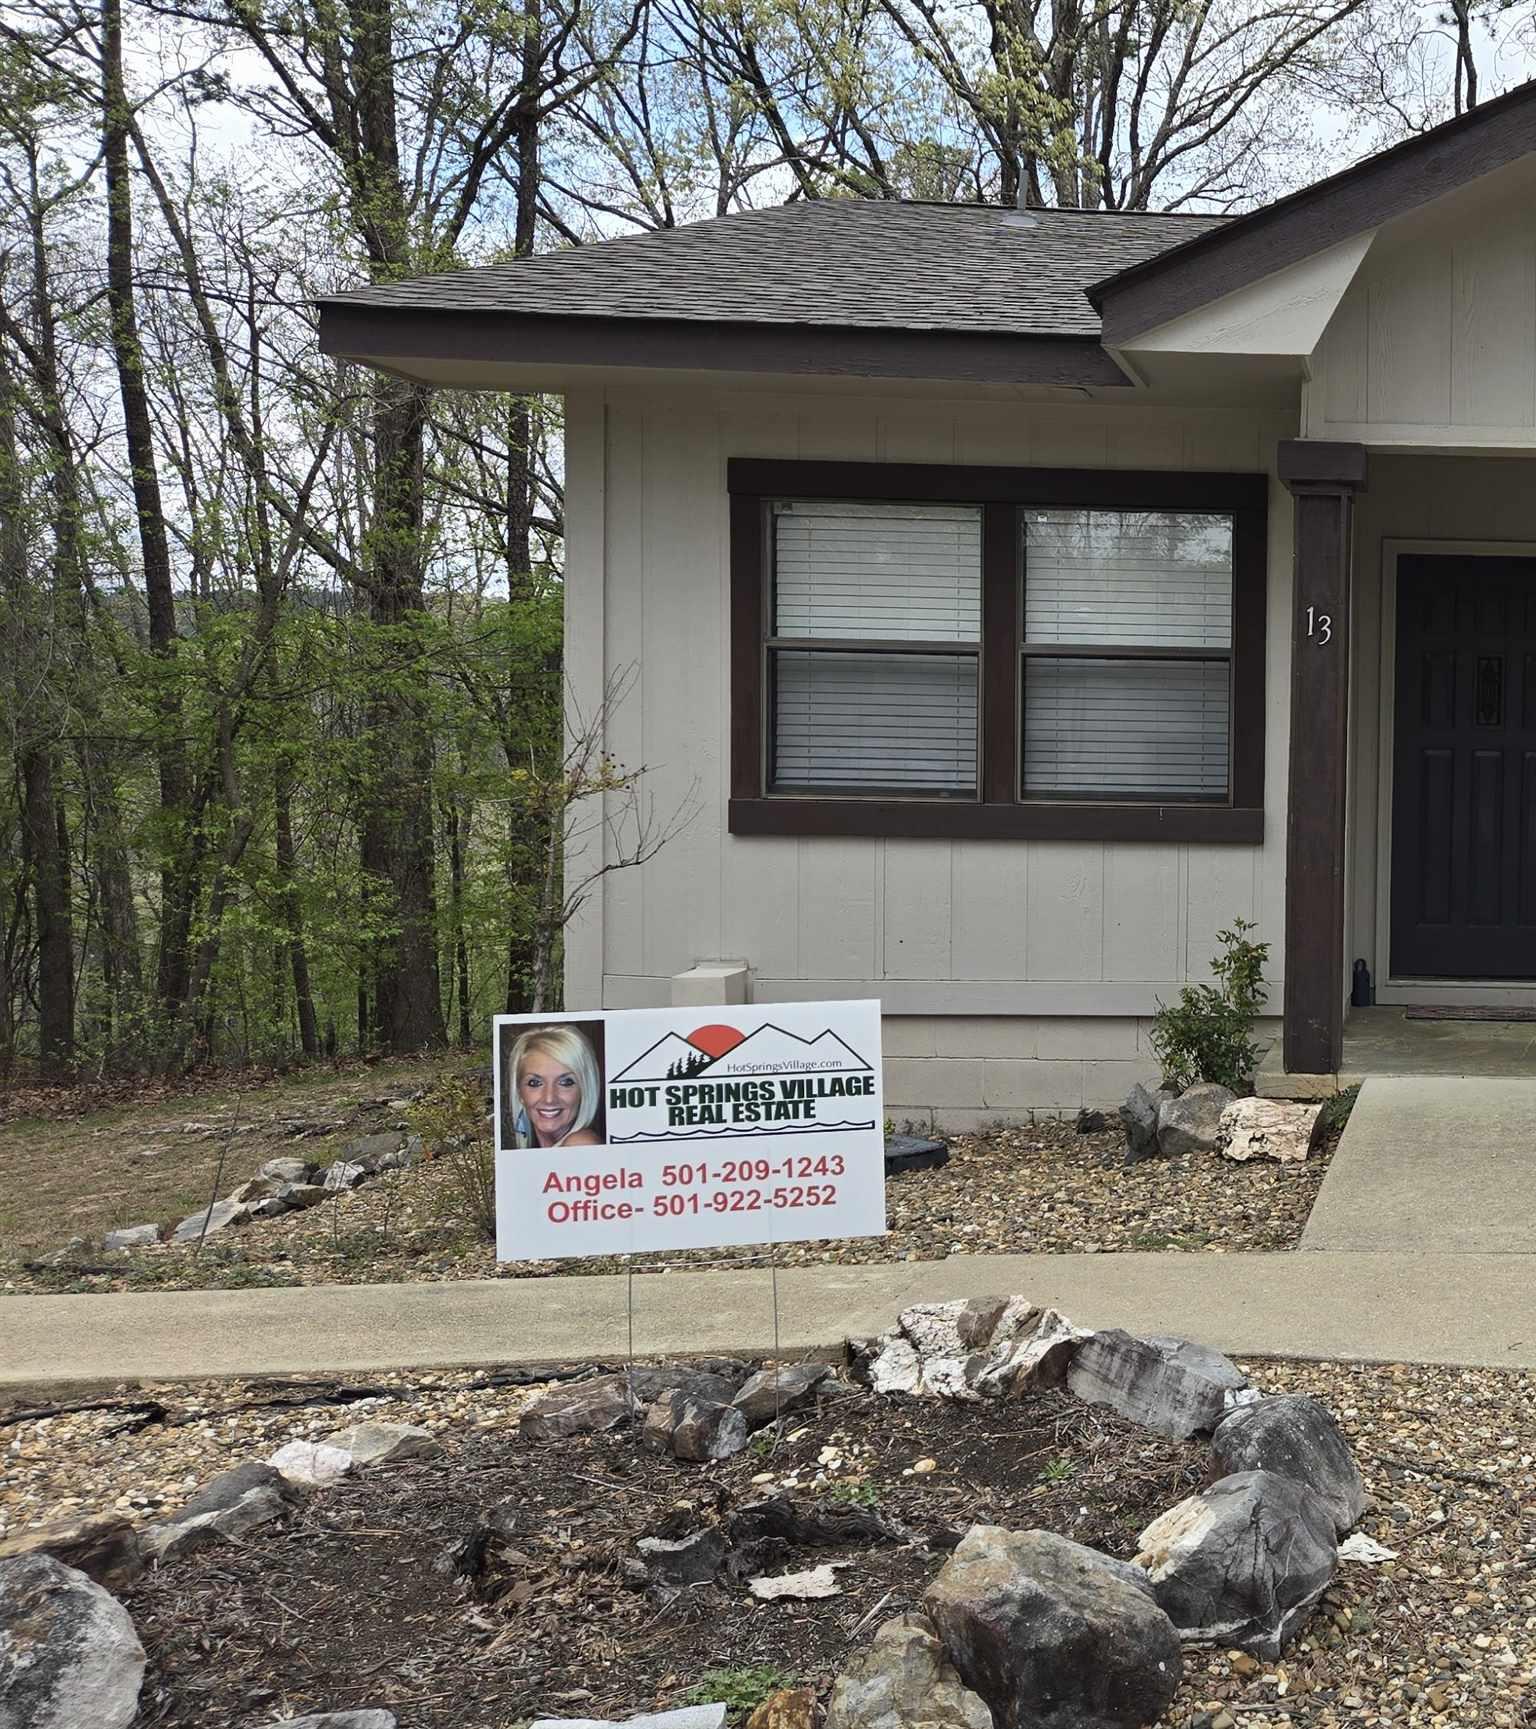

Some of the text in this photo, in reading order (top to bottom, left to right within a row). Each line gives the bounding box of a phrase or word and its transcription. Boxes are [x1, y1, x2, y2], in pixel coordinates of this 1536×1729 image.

[1306, 606, 1331, 645] 13
[727, 1058, 842, 1075] HotSpringsVillage.com
[609, 1076, 876, 1109] HOT SPRINGS VILLAGE
[668, 1099, 816, 1127] REAL ESTATE
[542, 1155, 845, 1196] Angela 501-209-1243
[547, 1185, 837, 1224] Office- 501-922-5252
